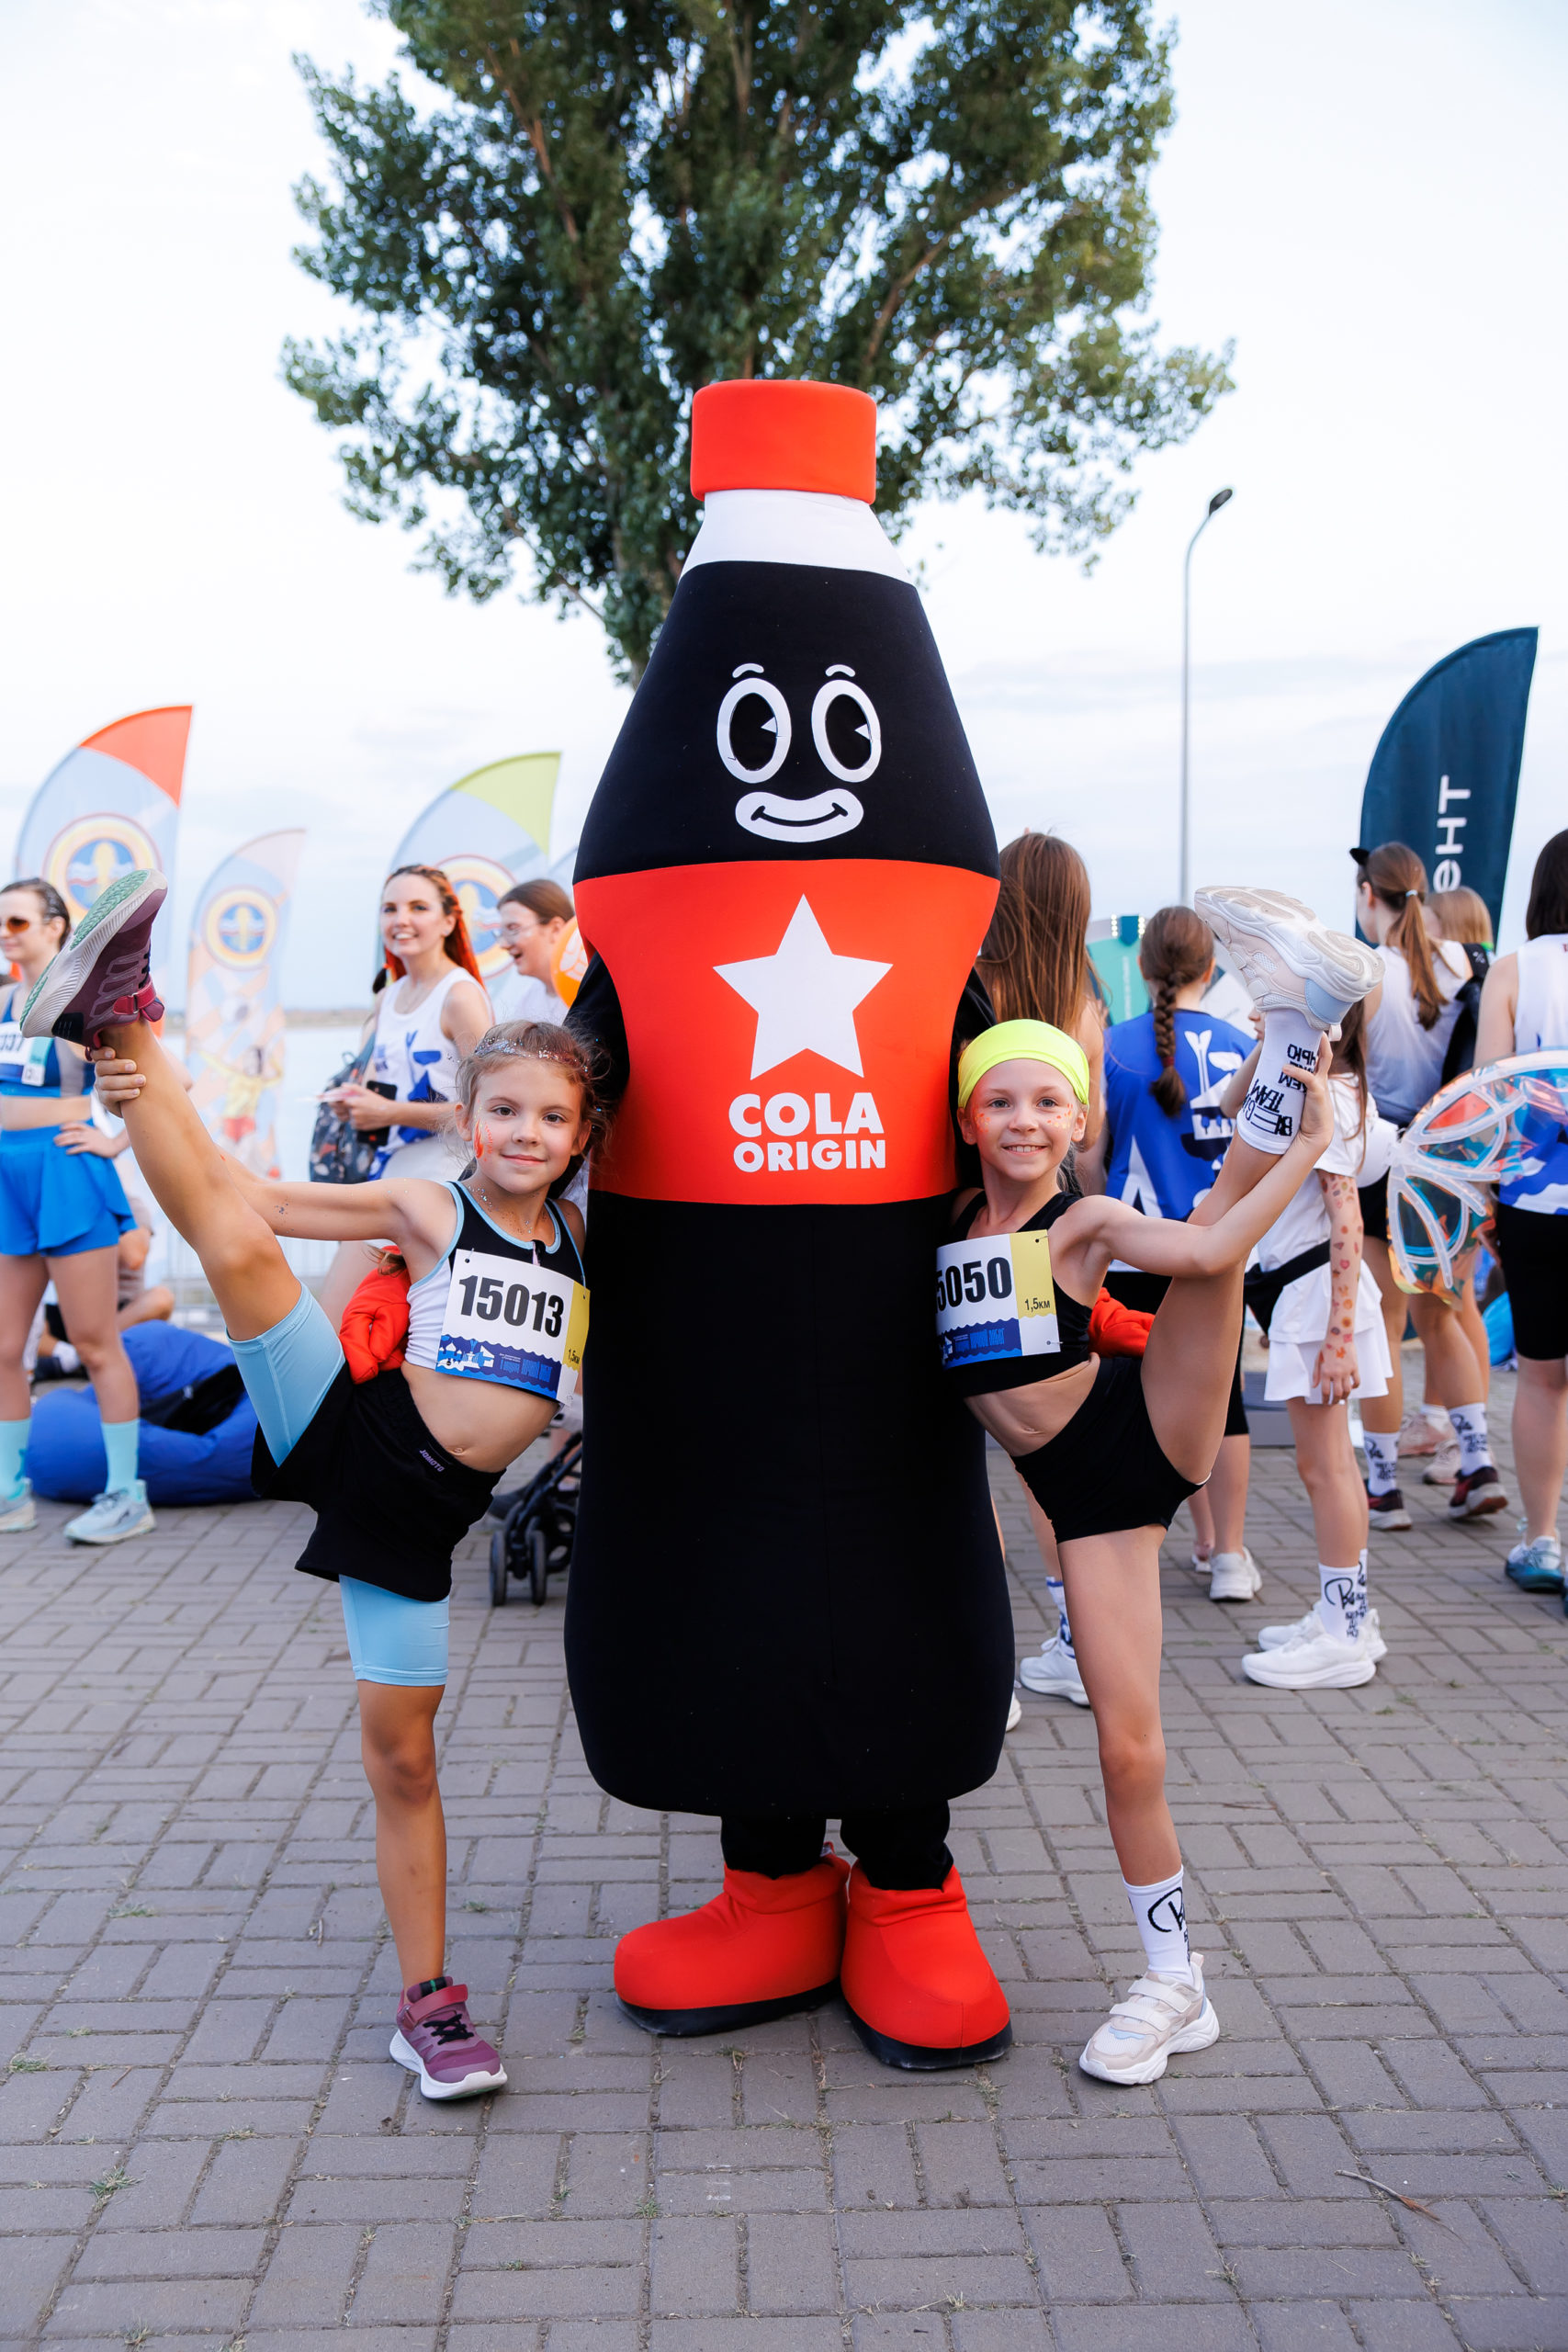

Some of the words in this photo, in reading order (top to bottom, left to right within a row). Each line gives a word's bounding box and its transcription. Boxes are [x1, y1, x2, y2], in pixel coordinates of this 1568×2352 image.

[1249, 1079, 1285, 1114] TEAM
[728, 1091, 885, 1138] COLA
[733, 1139, 886, 1173] ORIGIN
[458, 1274, 565, 1339] 15013
[419, 1449, 446, 1472] JOMOTO
